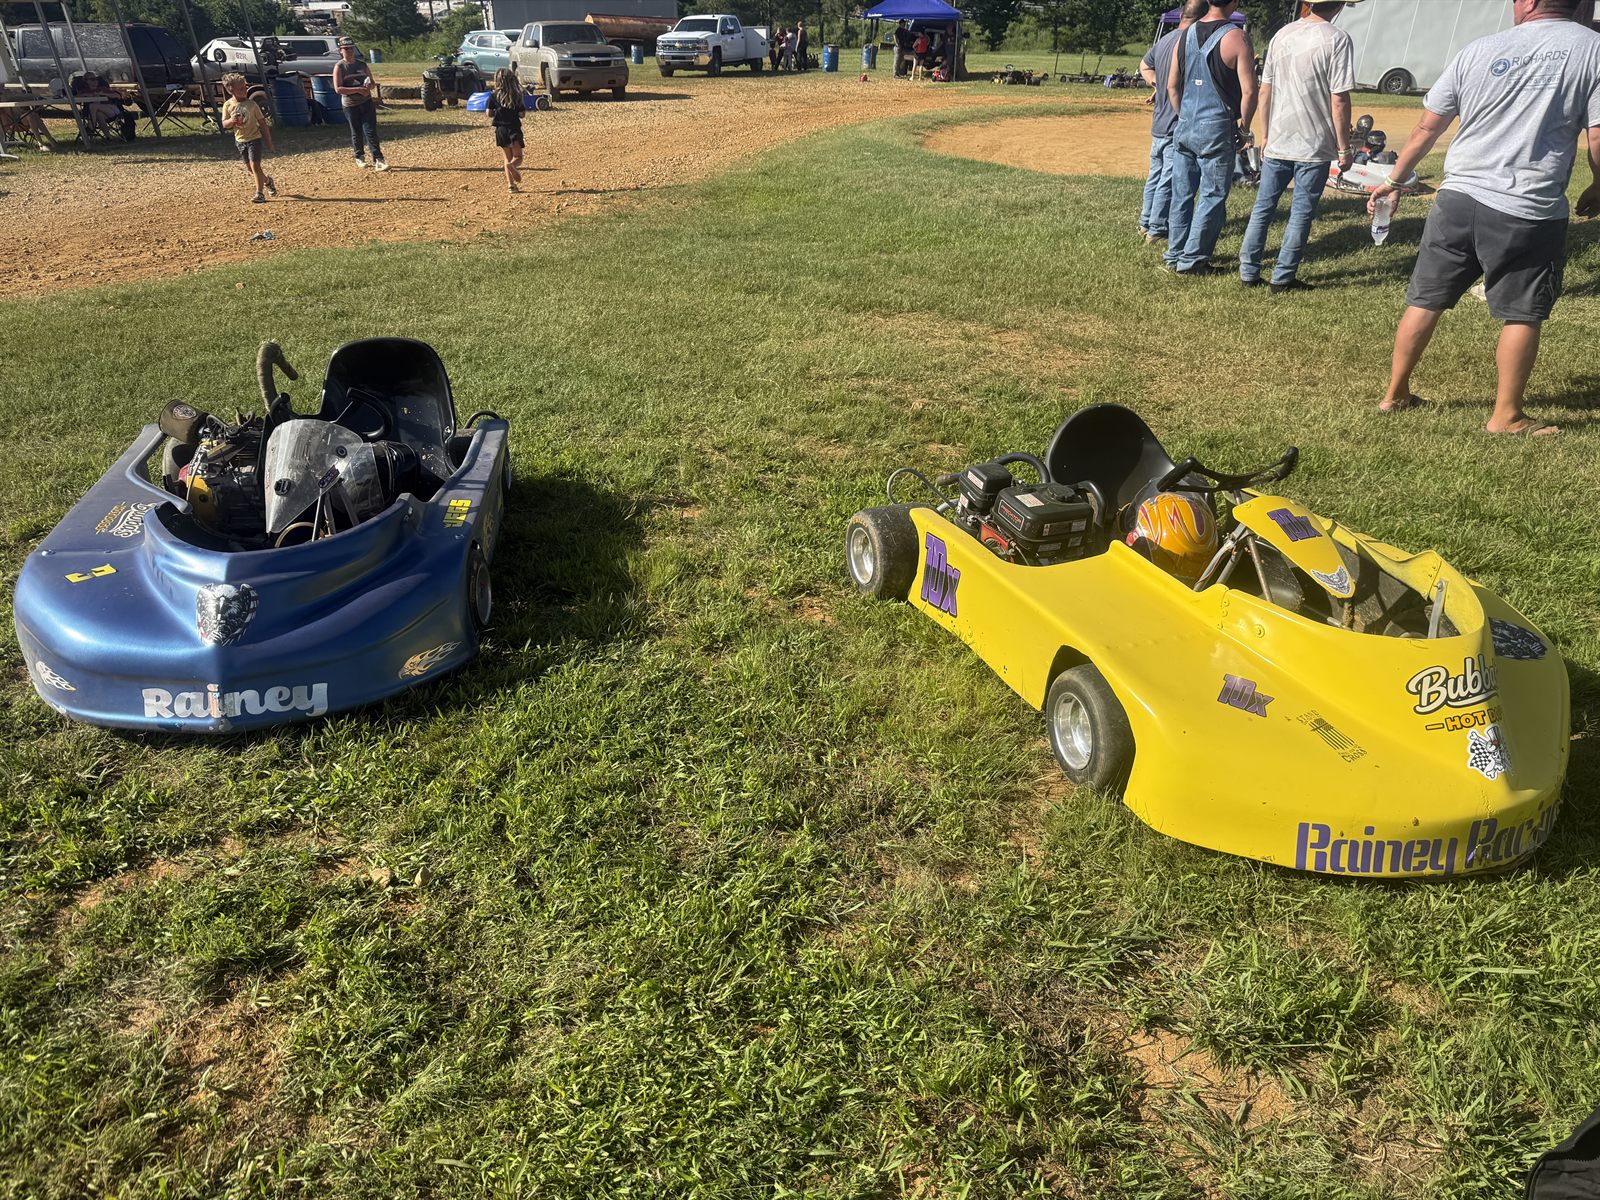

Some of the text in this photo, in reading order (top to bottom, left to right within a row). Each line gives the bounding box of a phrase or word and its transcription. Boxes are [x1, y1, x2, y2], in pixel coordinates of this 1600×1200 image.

[1512, 49, 1568, 66] RICHARDS
[142, 682, 328, 718] Rainey
[1445, 710, 1486, 731] HOT
[1295, 822, 1457, 875] Rainey
